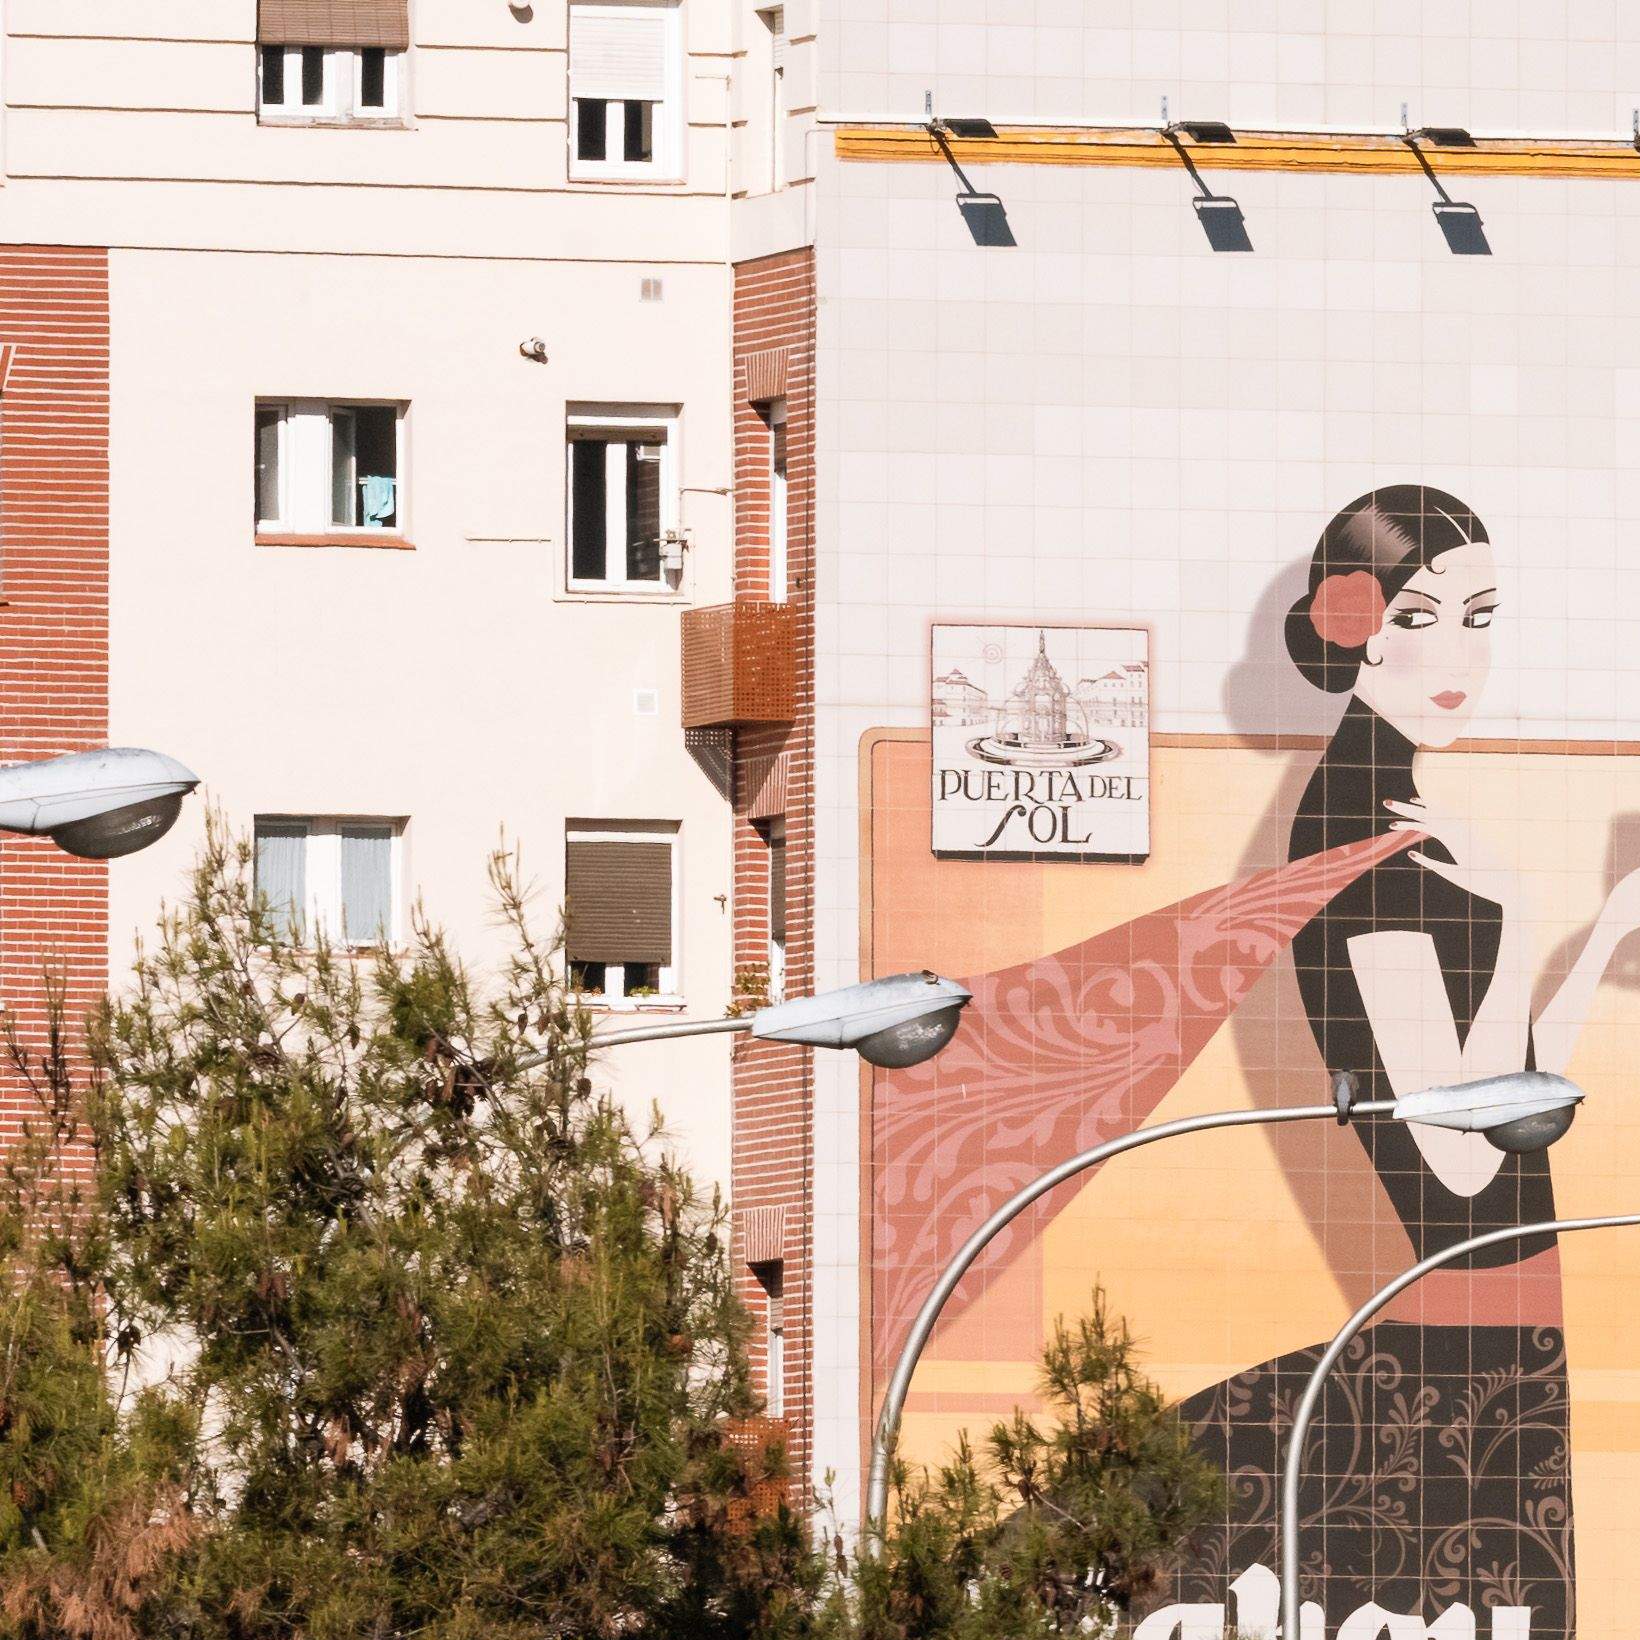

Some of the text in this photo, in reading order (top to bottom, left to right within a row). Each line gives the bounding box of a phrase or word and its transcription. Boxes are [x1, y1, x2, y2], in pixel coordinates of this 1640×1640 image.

[939, 769, 1143, 804] PUERTA DEL
[974, 804, 1093, 848] SOL
